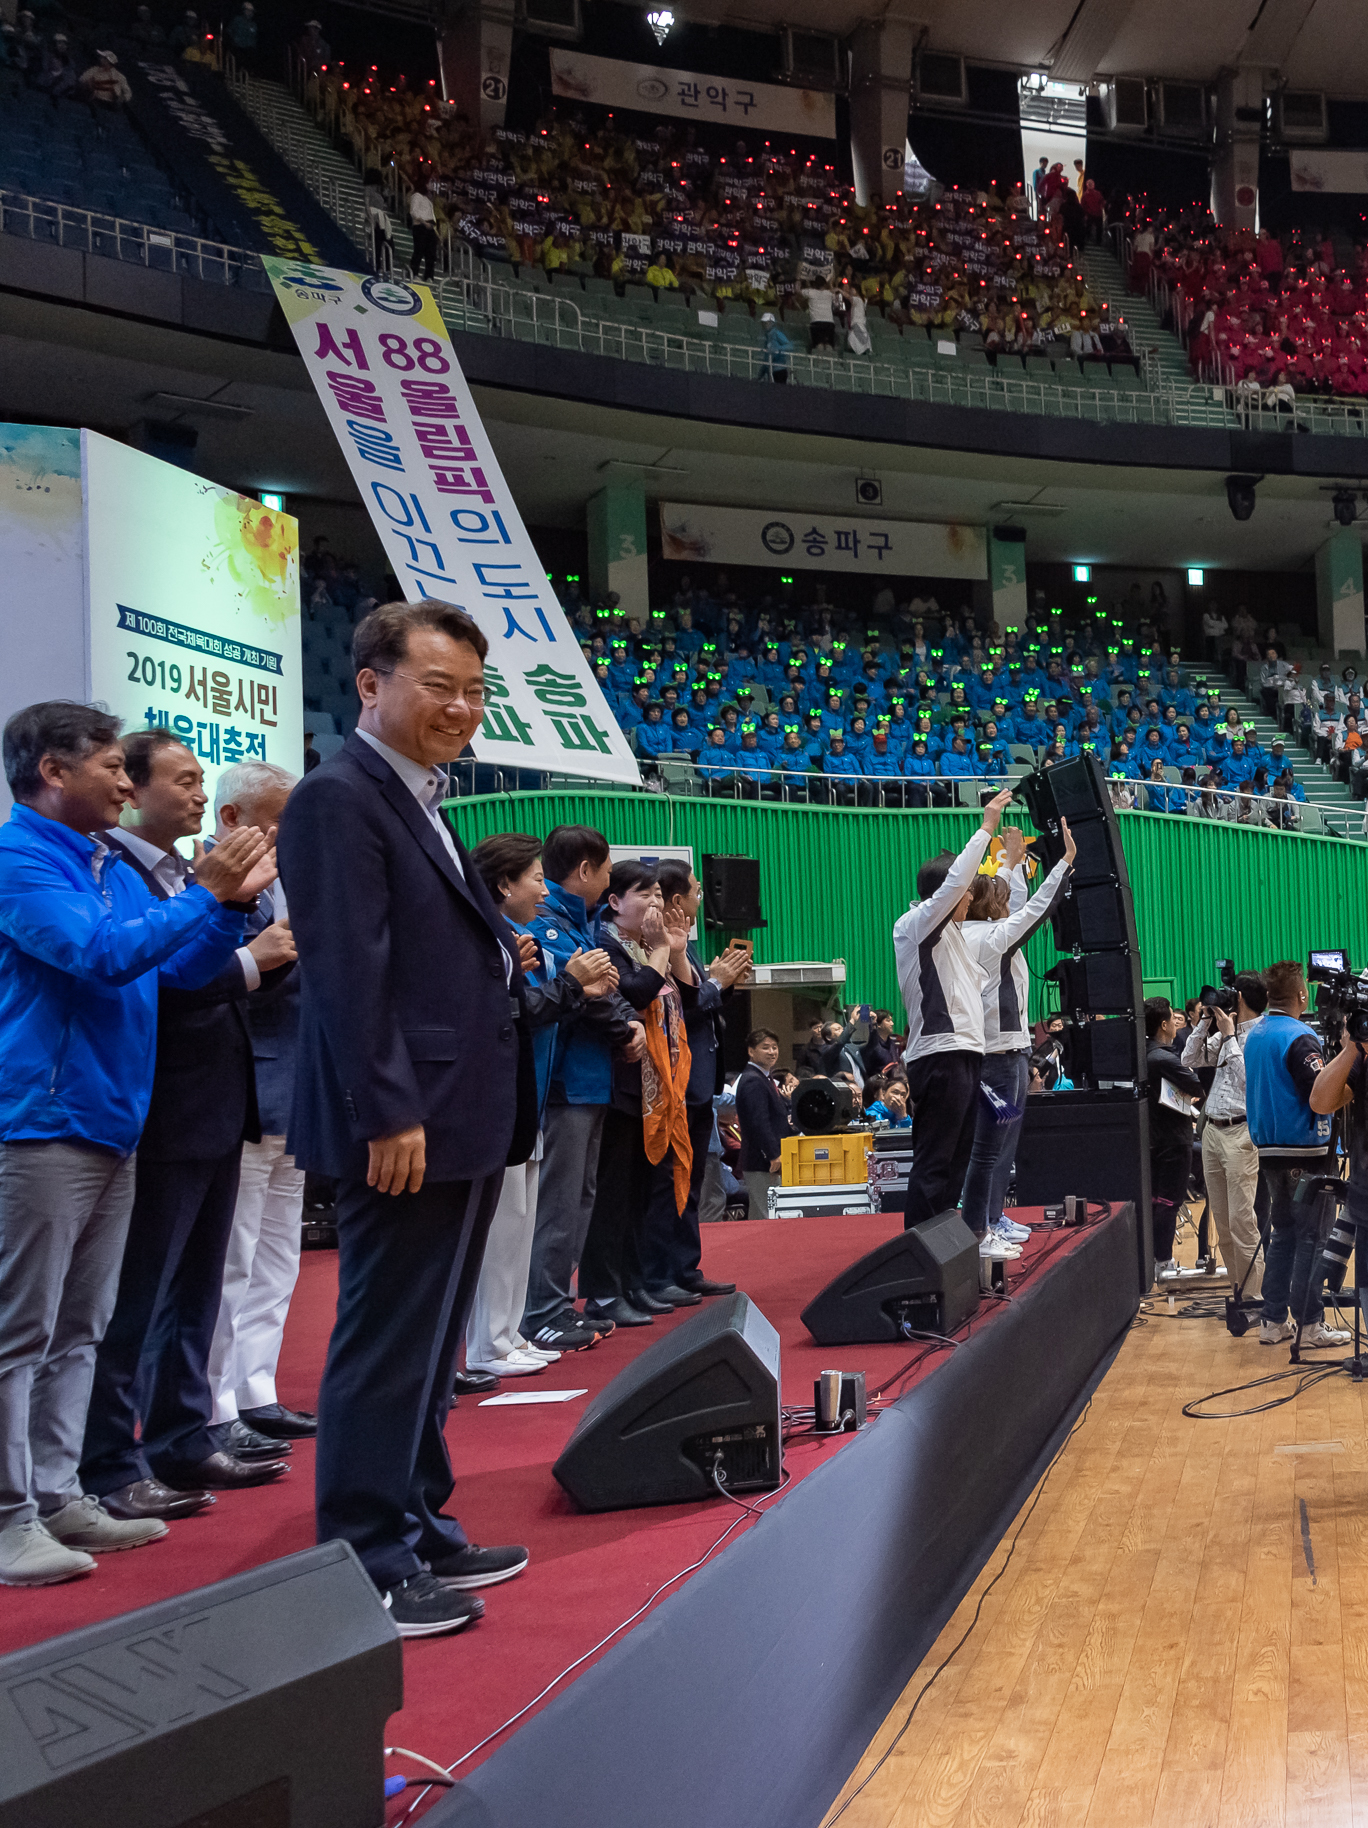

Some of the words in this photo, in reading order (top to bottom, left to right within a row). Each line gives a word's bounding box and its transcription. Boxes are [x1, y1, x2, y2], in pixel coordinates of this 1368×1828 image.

[485, 79, 504, 98] 21
[676, 80, 758, 116] 관악구
[886, 152, 902, 167] 21
[295, 288, 342, 305] 송파구
[313, 321, 406, 474] 서울을
[378, 333, 512, 545] 88올림픽의
[471, 562, 558, 643] 도시
[522, 662, 613, 757] 송파
[619, 534, 637, 558] 3
[801, 525, 893, 560] 송파구
[1001, 564, 1017, 587] 3
[1340, 577, 1358, 597] 4
[125, 611, 137, 629] 제
[137, 615, 167, 638] 100회
[167, 624, 223, 654] 전국체육대회
[223, 642, 242, 660] 성공
[242, 648, 260, 666] 개최
[260, 653, 278, 671] 기원
[126, 651, 183, 694] 2019
[184, 664, 278, 728] 서울시민
